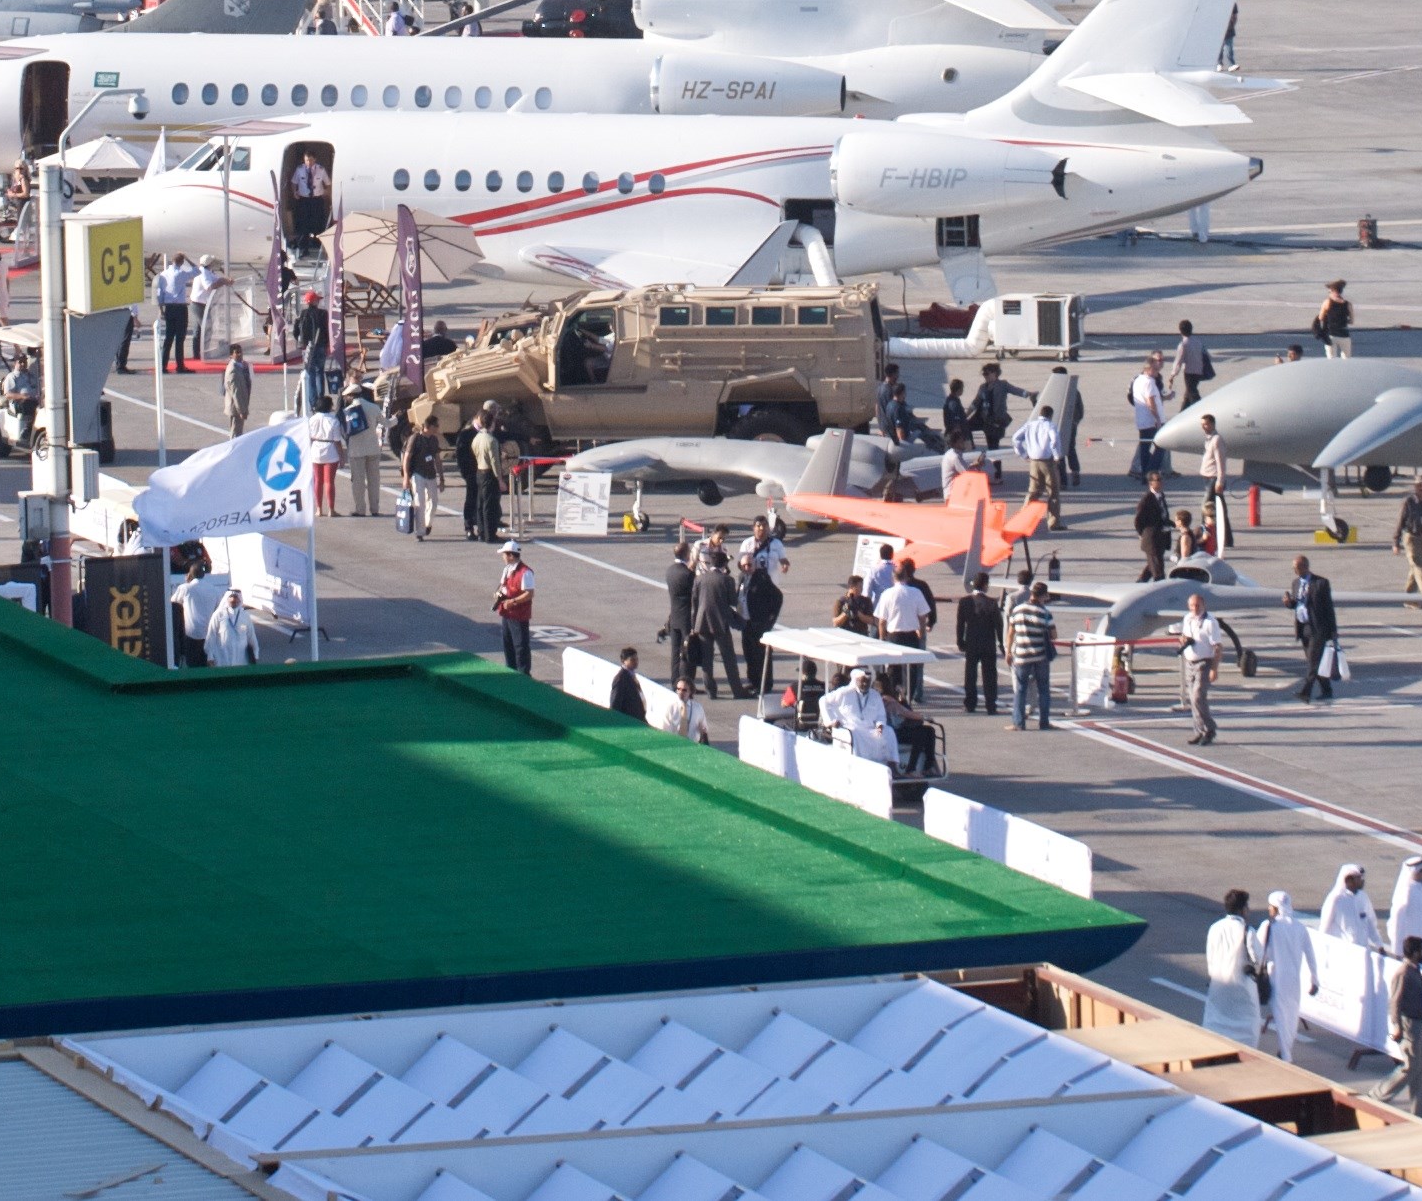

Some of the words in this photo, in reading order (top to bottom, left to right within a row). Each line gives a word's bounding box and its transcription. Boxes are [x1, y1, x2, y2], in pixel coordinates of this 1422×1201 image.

[681, 80, 777, 100] HZ-SPAI
[879, 168, 969, 189] F-HBIP
[101, 243, 131, 286] G5
